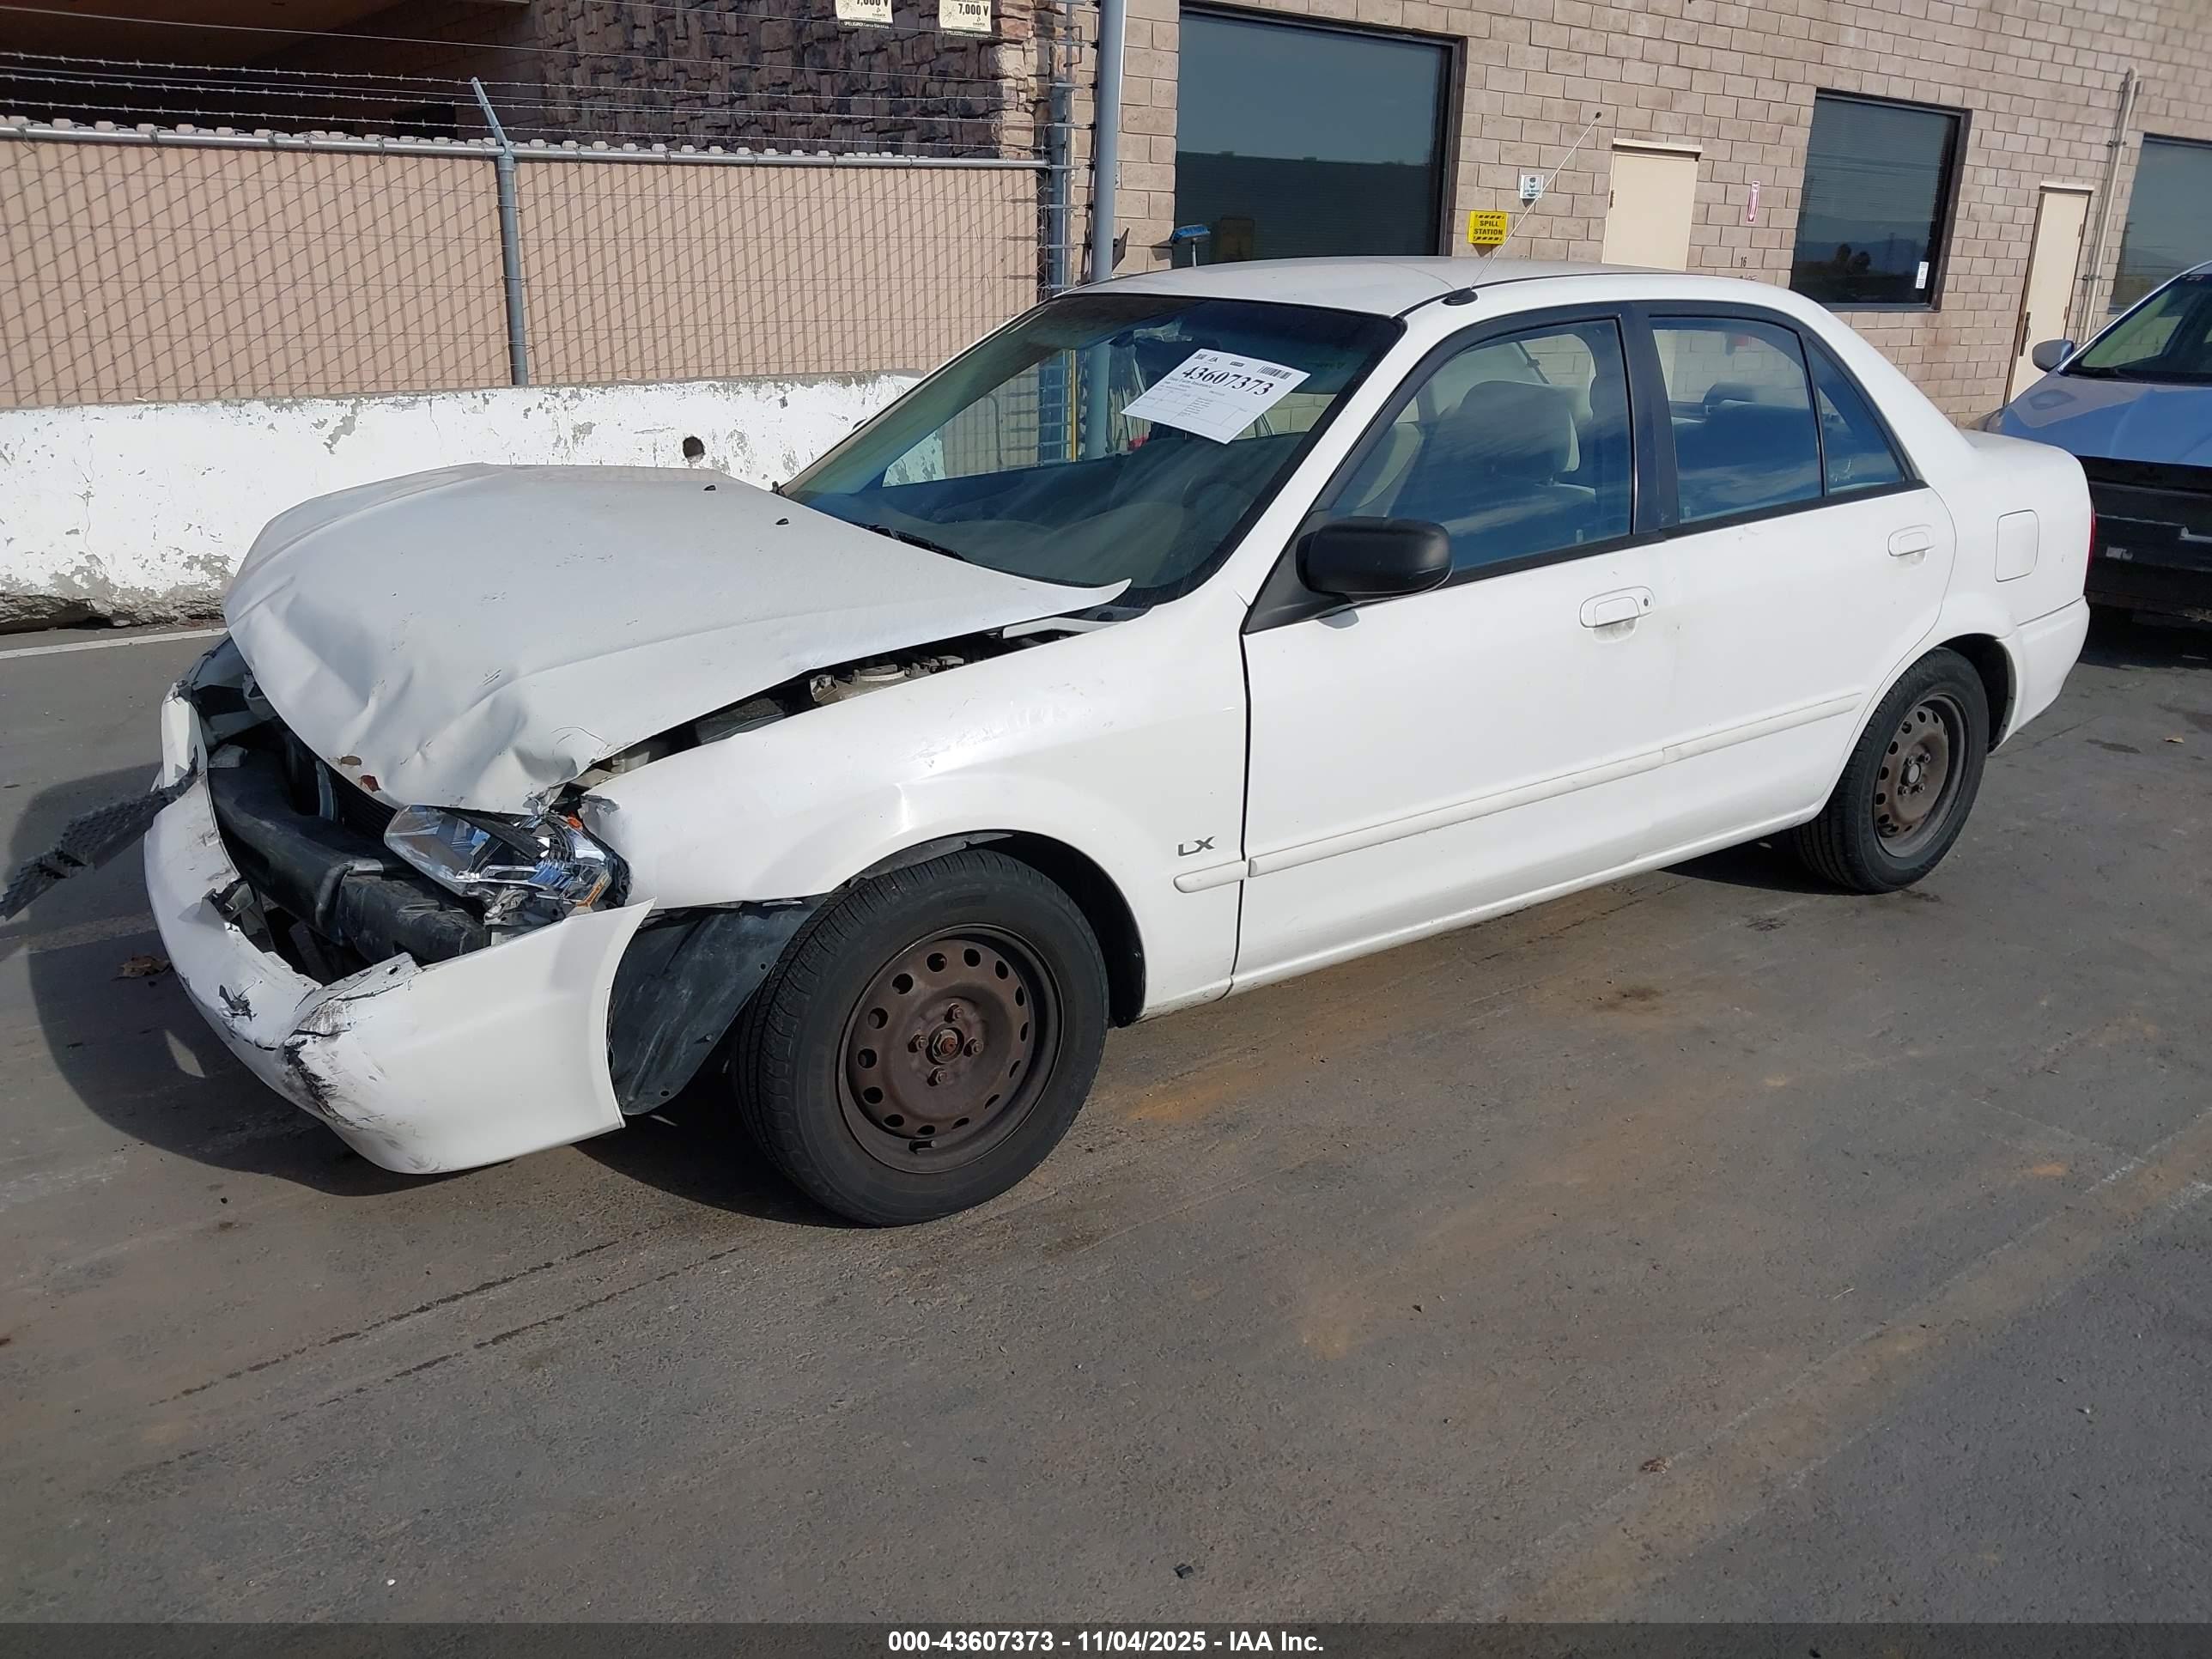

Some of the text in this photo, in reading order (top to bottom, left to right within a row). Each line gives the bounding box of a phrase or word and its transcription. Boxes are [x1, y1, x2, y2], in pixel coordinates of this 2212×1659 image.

[958, 3, 990, 16] 7,000 V
[1741, 256, 1747, 267] 16
[1182, 366, 1274, 396] 43607373
[1178, 836, 1215, 856] LX
